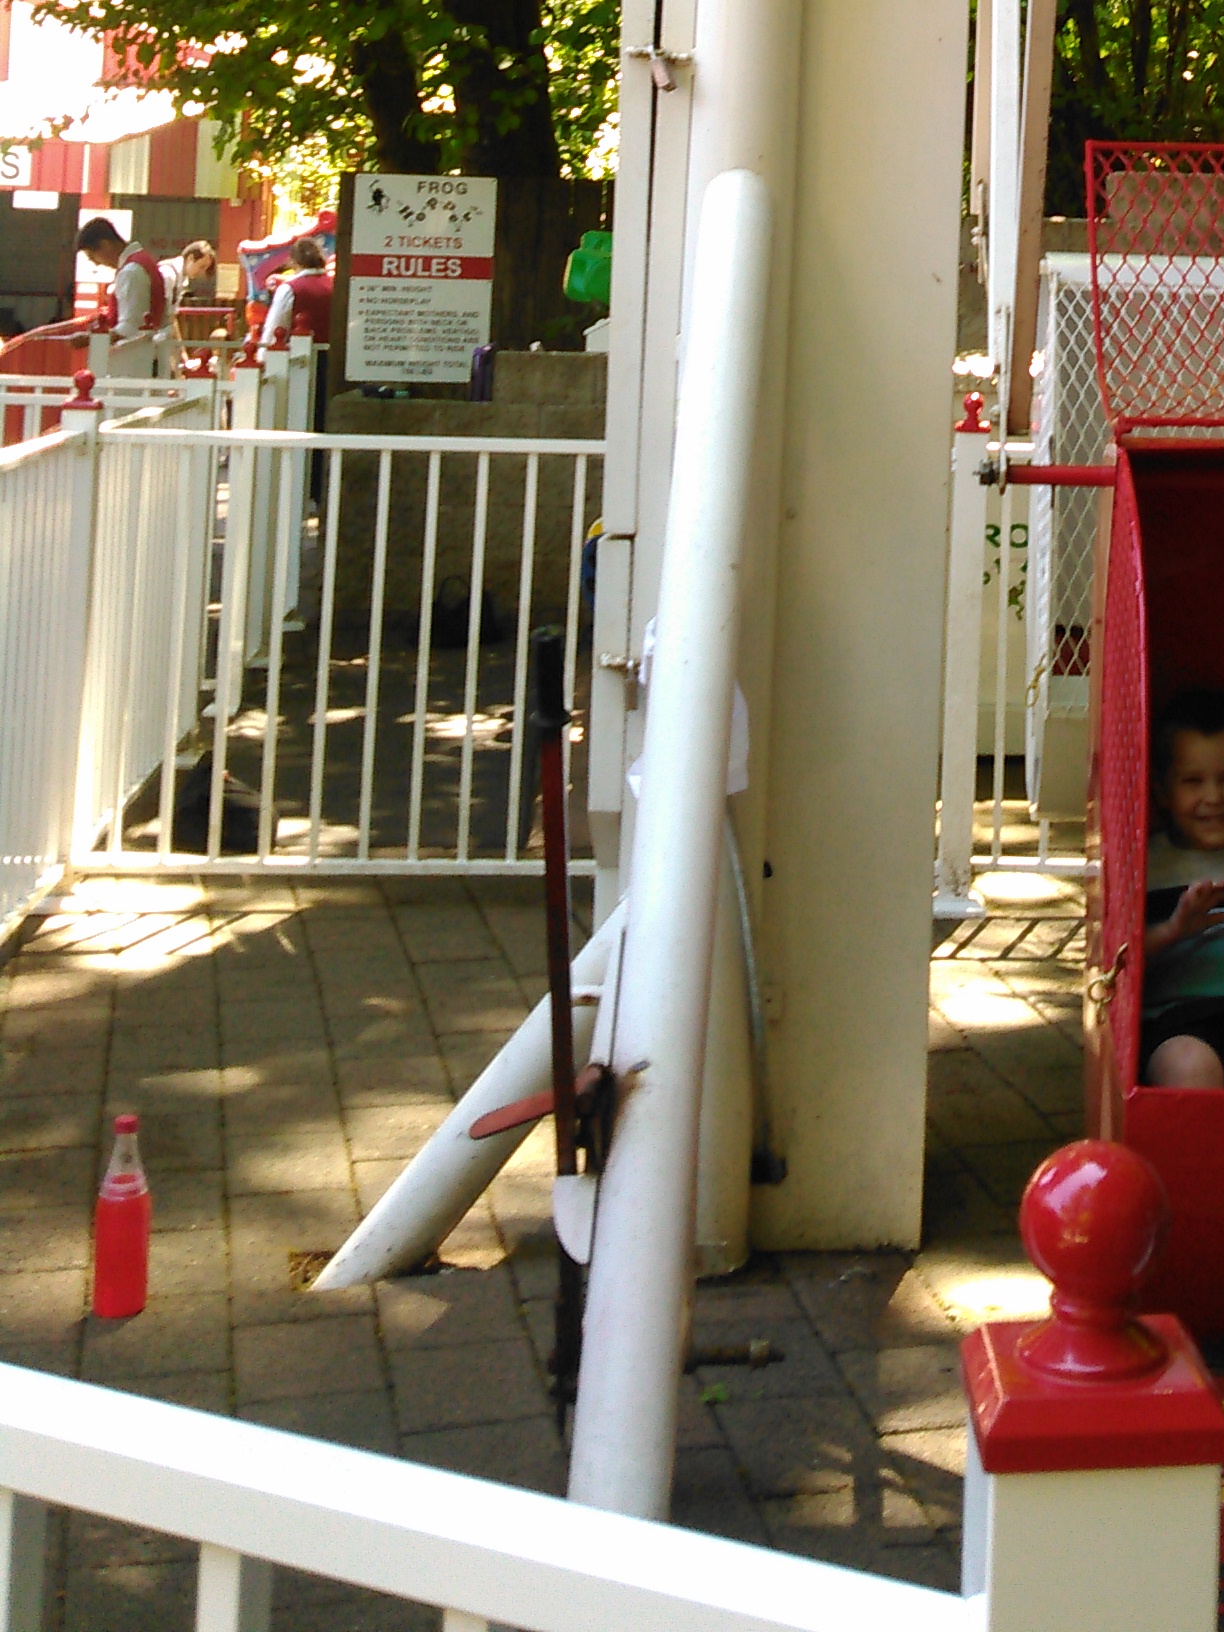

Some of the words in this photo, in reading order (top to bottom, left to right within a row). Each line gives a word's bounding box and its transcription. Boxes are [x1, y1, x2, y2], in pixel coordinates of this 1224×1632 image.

[417, 180, 468, 195] FROG
[384, 235, 394, 248] 2
[398, 235, 464, 250] TICKETS
[382, 256, 463, 277] RULES
